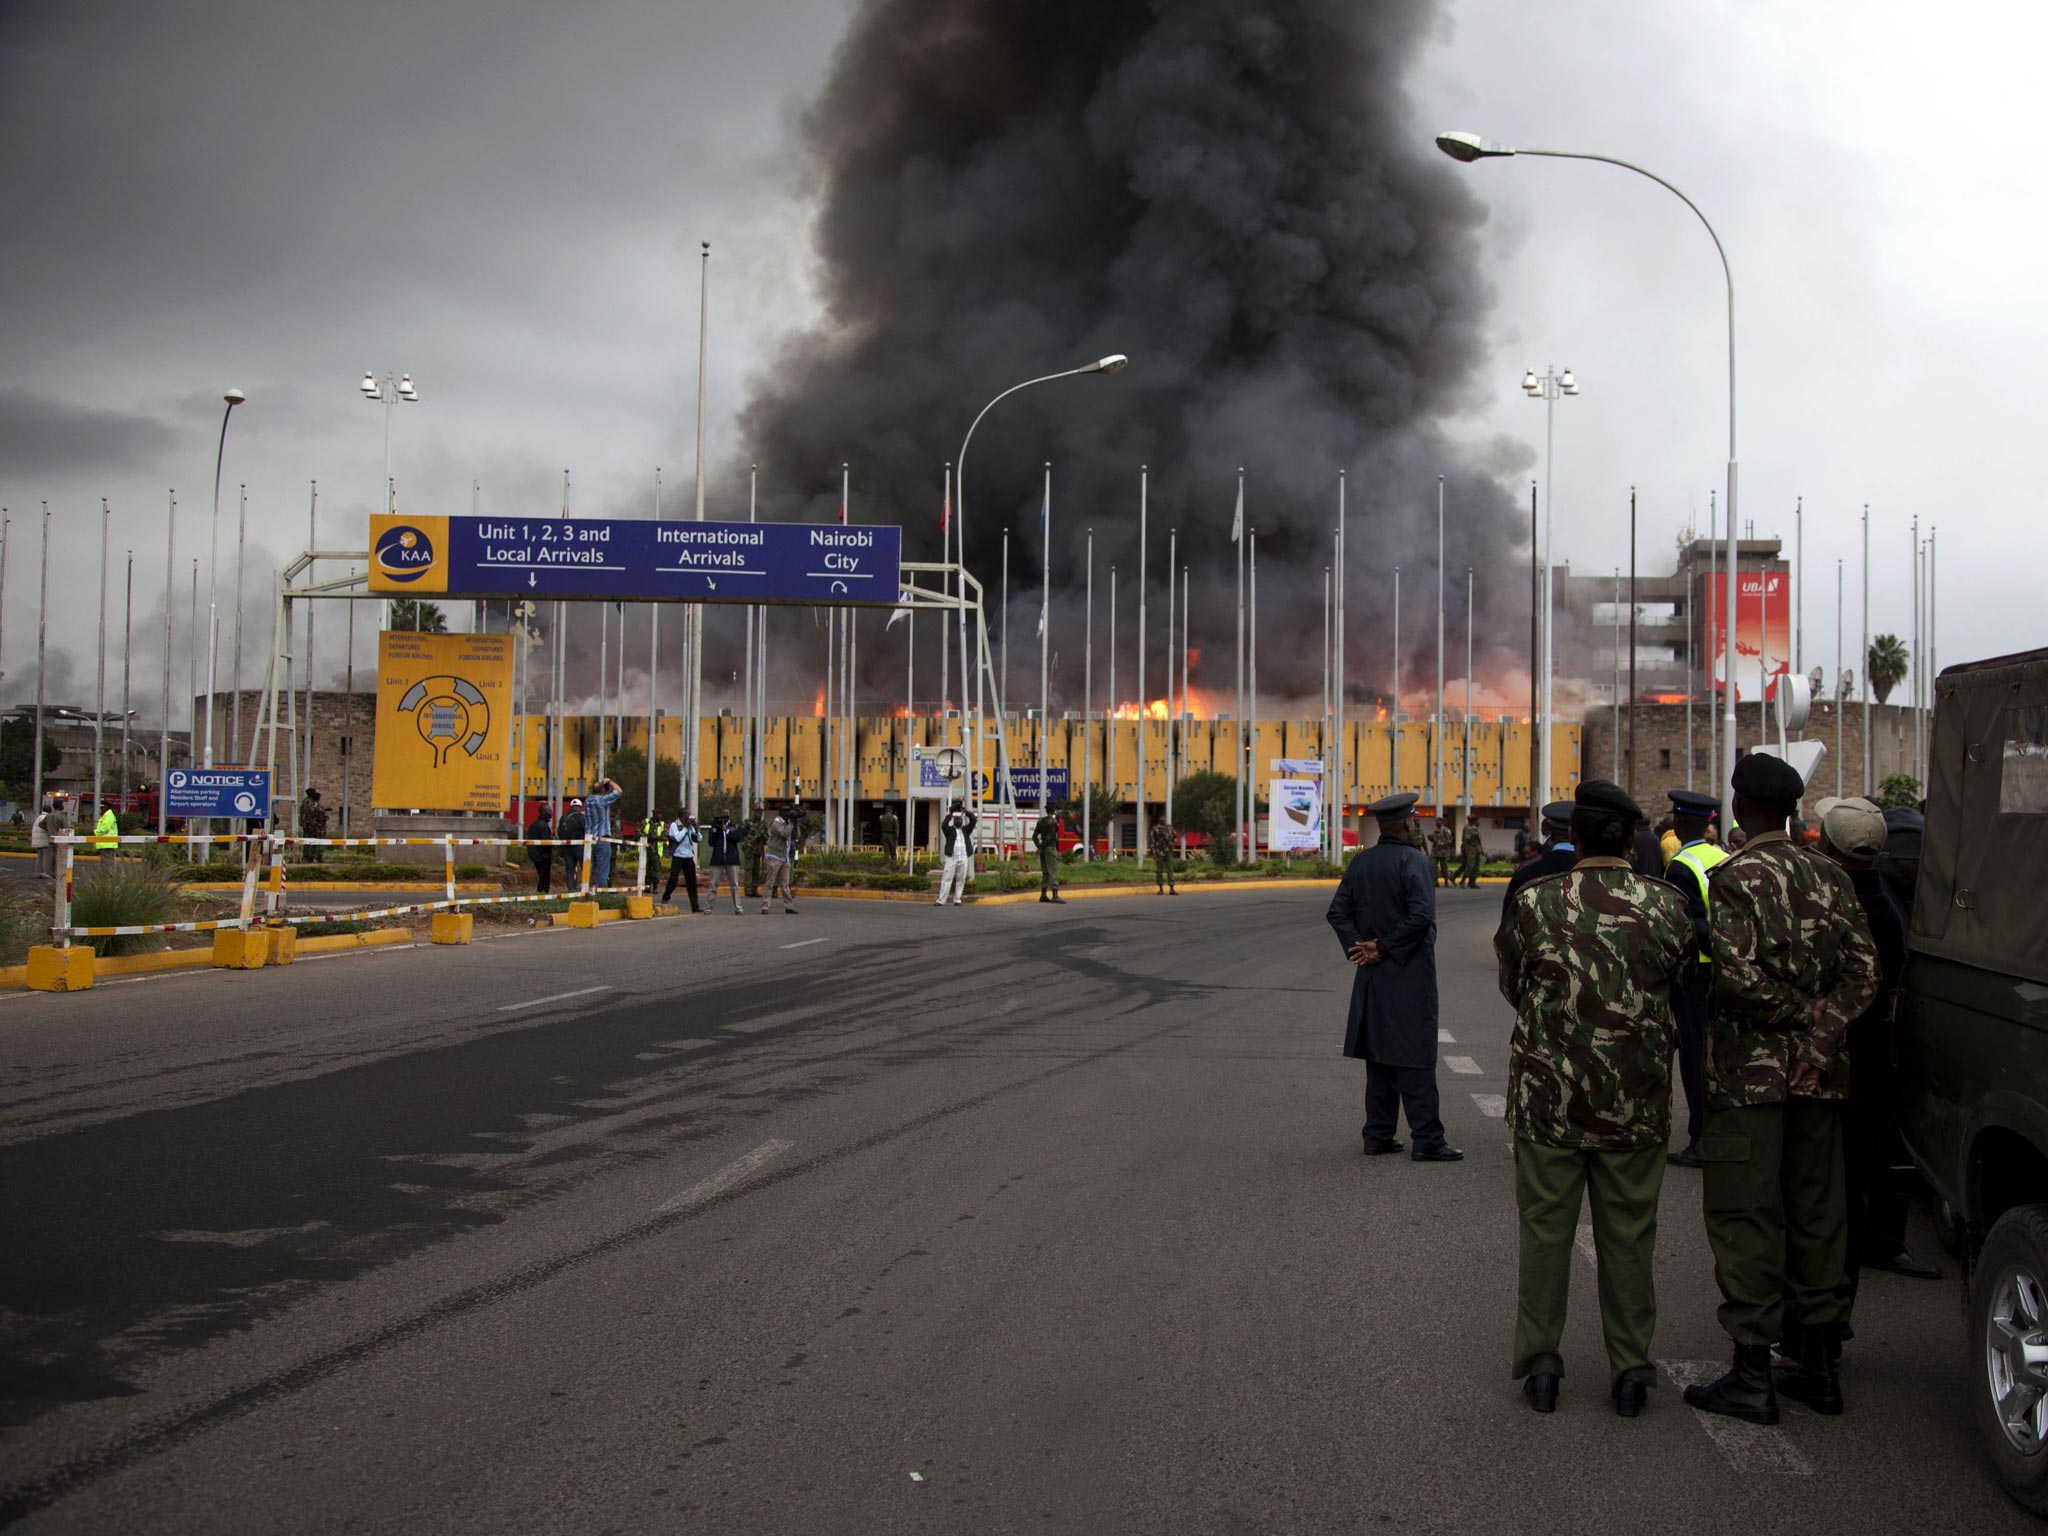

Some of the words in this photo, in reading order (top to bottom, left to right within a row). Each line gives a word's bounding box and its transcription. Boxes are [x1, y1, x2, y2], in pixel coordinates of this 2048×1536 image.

[478, 523, 516, 540] Unit
[522, 525, 537, 543] 1,
[541, 525, 558, 543] 2,
[563, 525, 574, 541] 3
[579, 526, 611, 542] and
[657, 527, 764, 545] International
[810, 530, 874, 547] Nairobi
[401, 549, 431, 561] KAA
[486, 545, 531, 562] Local
[537, 547, 605, 563] Arrivals
[678, 549, 746, 567] Arrivals
[824, 553, 859, 572] City
[386, 678, 403, 686] Unit
[405, 678, 409, 686] 1
[479, 680, 496, 688] Unit
[423, 712, 464, 720] INTERNATIONAL
[431, 722, 456, 730] ARRIVALS
[476, 753, 493, 761] Unit
[173, 774, 184, 786] P
[191, 775, 245, 785] NOTICE
[995, 771, 1066, 784] Iernatonal
[469, 791, 501, 799] DEPARTURES
[1012, 785, 1052, 798] Arrivas
[477, 801, 501, 809] ARRIVALS
